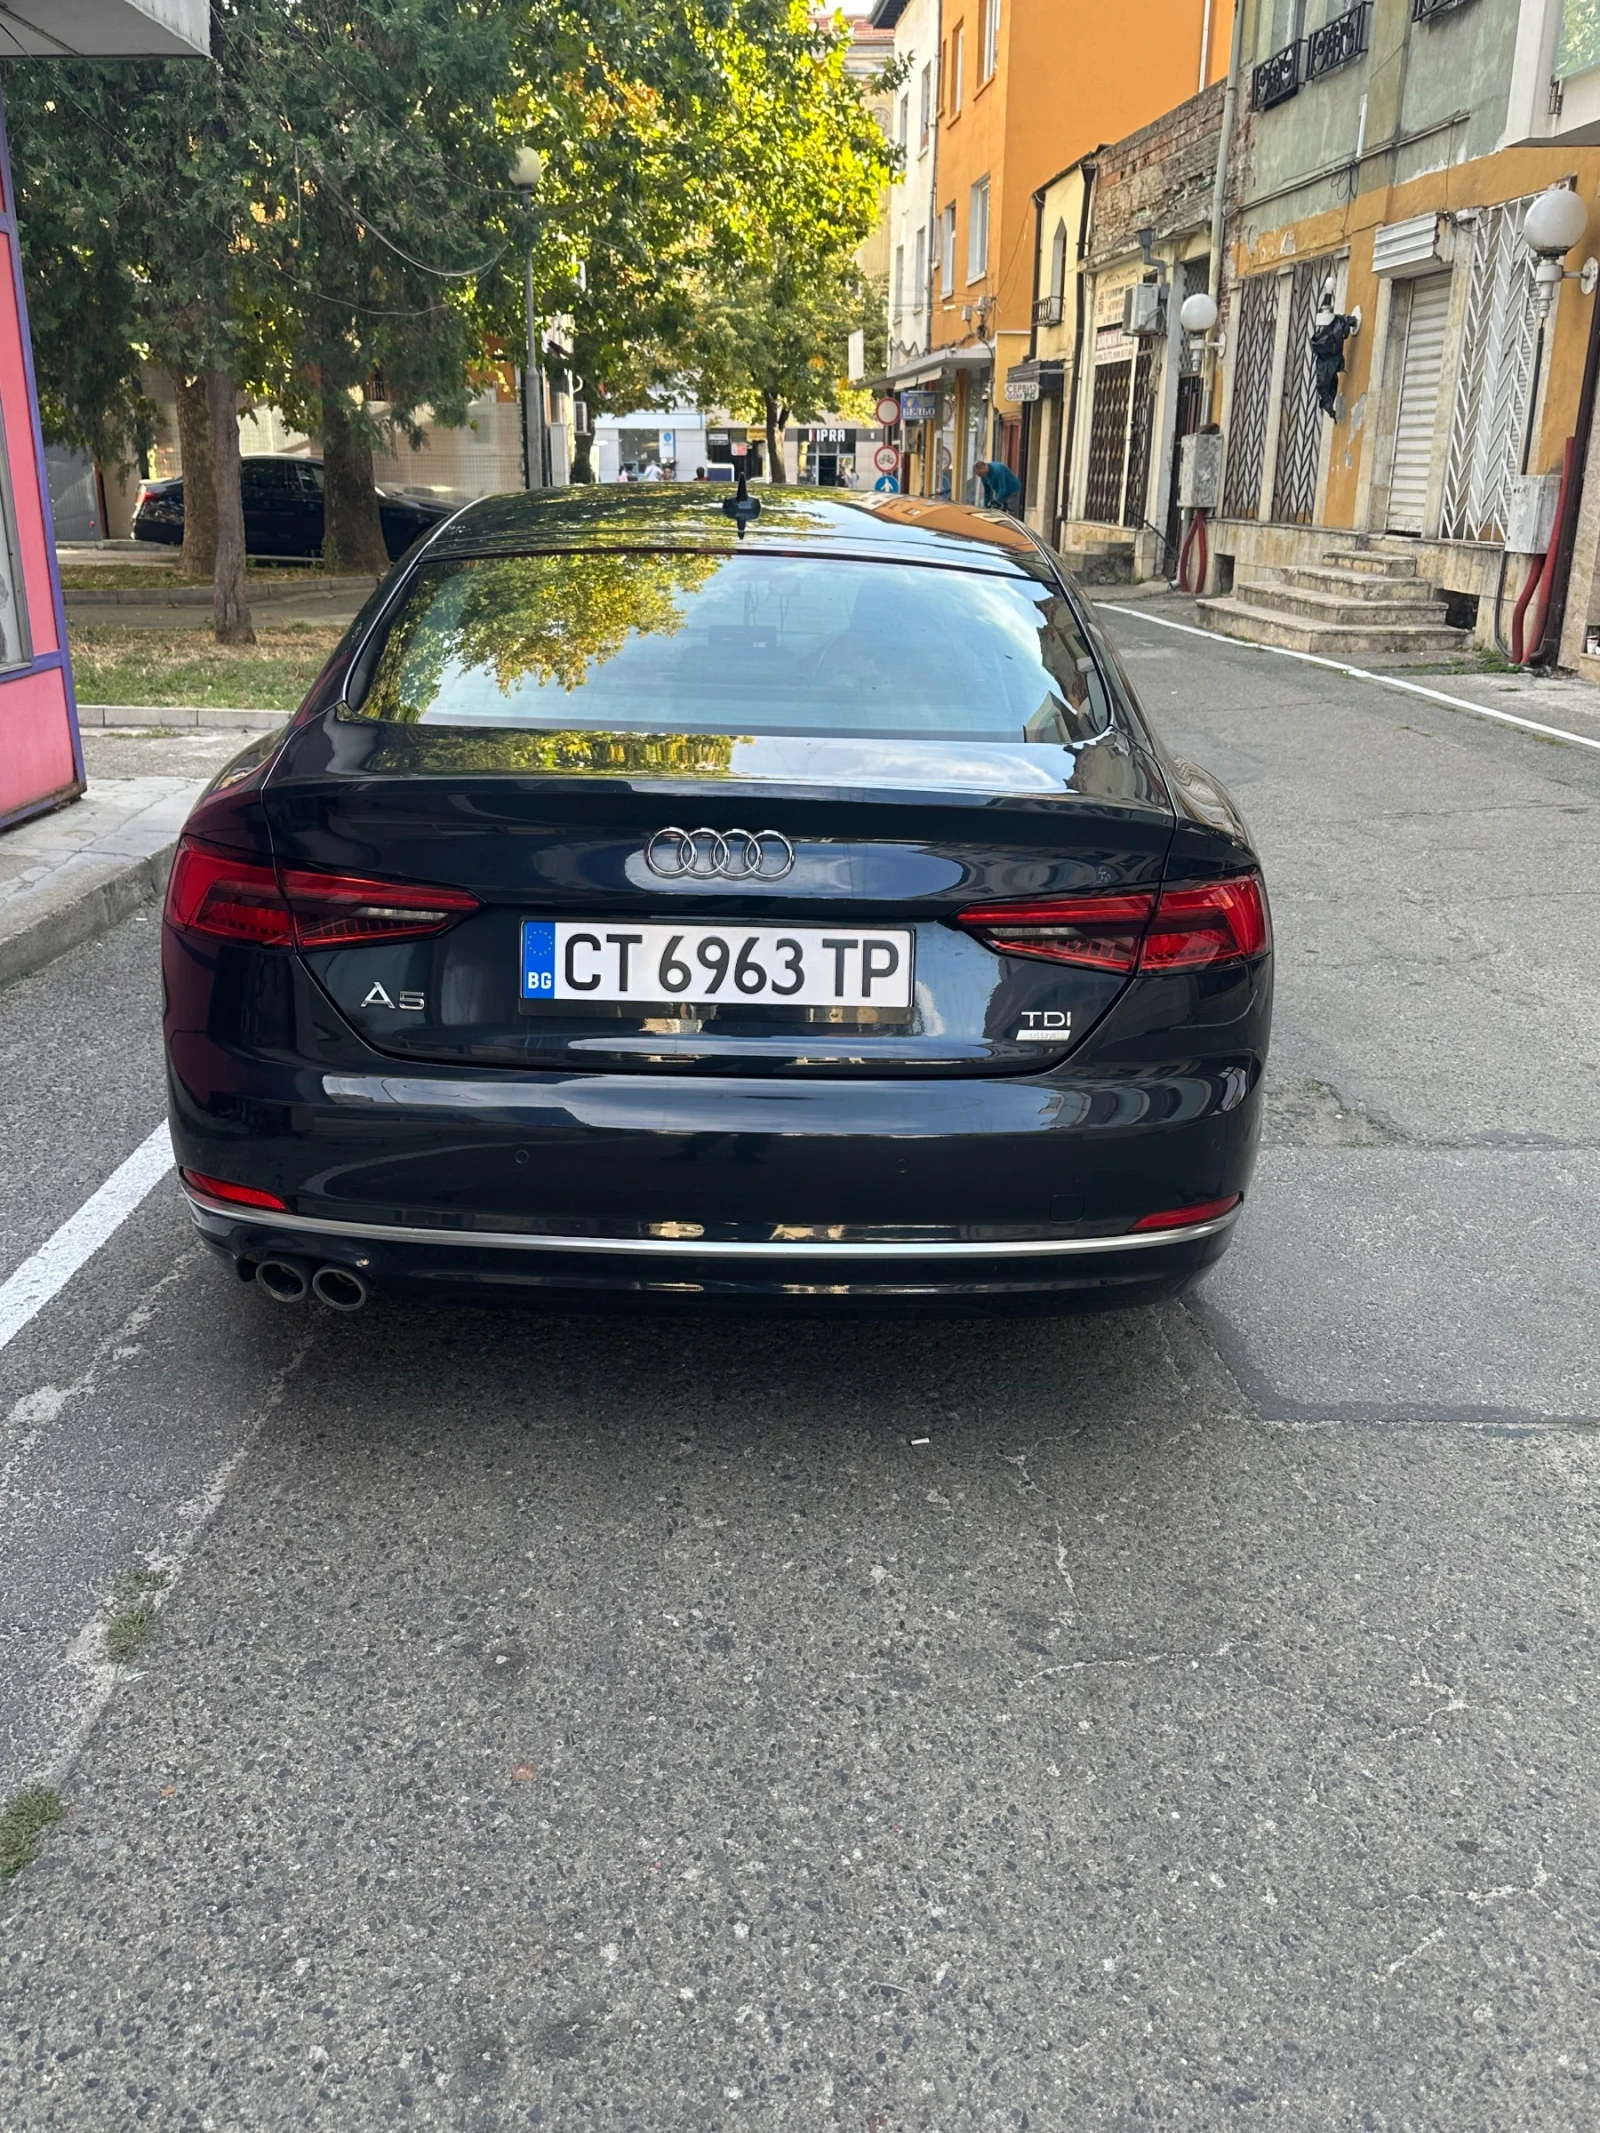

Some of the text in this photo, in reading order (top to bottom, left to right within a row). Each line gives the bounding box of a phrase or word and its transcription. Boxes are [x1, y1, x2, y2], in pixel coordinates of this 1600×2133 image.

[1006, 384, 1037, 393] СЕРВИЗ
[1024, 392, 1036, 400] PC
[902, 407, 936, 416] БЕЛЬО
[808, 429, 846, 442] KIPRA
[564, 932, 900, 998] CT 6963 TP
[527, 971, 552, 989] BG
[360, 981, 425, 1010] A5
[1020, 1011, 1072, 1027] TDI
